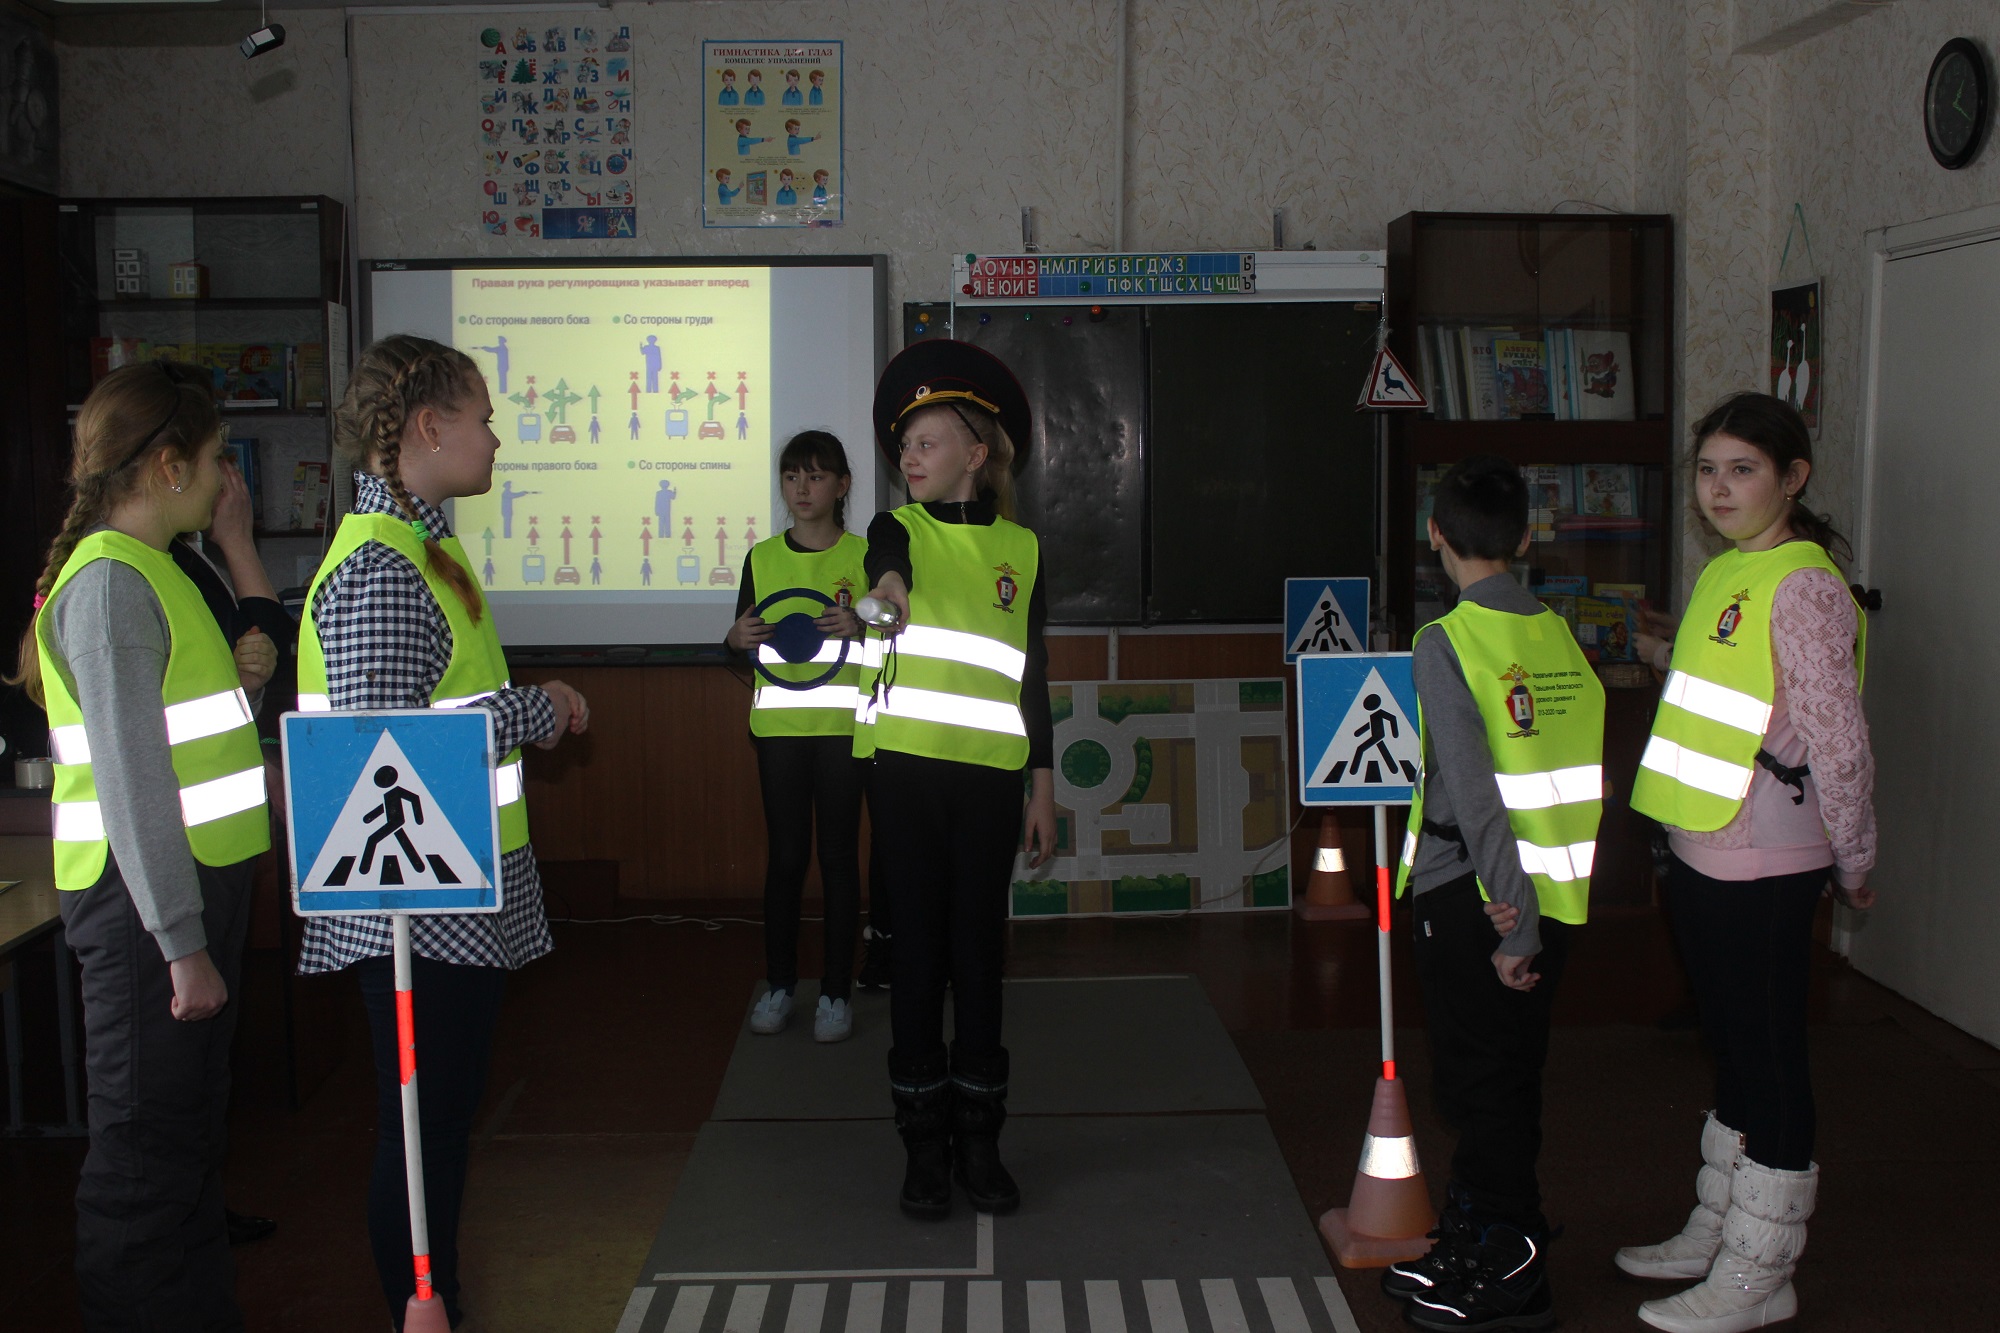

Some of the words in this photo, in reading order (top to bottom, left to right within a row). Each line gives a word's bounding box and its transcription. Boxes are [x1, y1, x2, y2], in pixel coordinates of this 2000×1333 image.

[495, 42, 507, 54] А
[527, 41, 537, 52] Б
[558, 40, 567, 52] В
[574, 28, 581, 40] Г
[619, 26, 630, 39] Д
[713, 48, 780, 57] ГИМНАСТИКА
[808, 48, 833, 57] ГЛАЗ
[529, 59, 537, 75] Ё
[542, 72, 557, 84] Ж
[590, 70, 599, 83] З
[617, 70, 629, 82] И
[495, 88, 507, 103] Й
[528, 102, 539, 114] К
[543, 88, 554, 102] Л
[573, 87, 587, 100] М
[619, 100, 630, 113] Н
[481, 118, 494, 132] О
[512, 119, 523, 132] П
[561, 132, 571, 145] Р
[574, 118, 585, 132] С
[605, 118, 614, 131] Т
[497, 150, 509, 164] У
[524, 162, 540, 175] Ф
[557, 160, 570, 174] Х
[589, 161, 602, 176] Ц
[621, 148, 632, 160] Ч
[493, 192, 507, 205] Ш
[525, 179, 540, 194] Щ
[544, 194, 554, 206] Ь
[560, 179, 571, 191] Ъ
[587, 193, 601, 206] Ы
[623, 193, 634, 205] Э
[482, 210, 500, 224] Ю
[529, 224, 540, 237] Я
[617, 215, 633, 237] А
[472, 278, 515, 290] Правая
[518, 280, 545, 289] рука
[548, 279, 640, 289] регулировщика
[642, 279, 705, 289] указывает
[707, 279, 750, 289] вперед
[469, 315, 483, 325] Со
[485, 316, 528, 327] стороны
[530, 316, 564, 325] левого
[566, 314, 590, 325] бока
[623, 314, 638, 325] Со
[640, 316, 682, 326] стороны
[685, 316, 713, 326] груди
[493, 462, 529, 472] тороны
[531, 462, 571, 472] правого
[574, 460, 597, 471] бока
[639, 460, 653, 470] Со
[655, 462, 697, 472] стороны
[699, 461, 731, 470] спины
